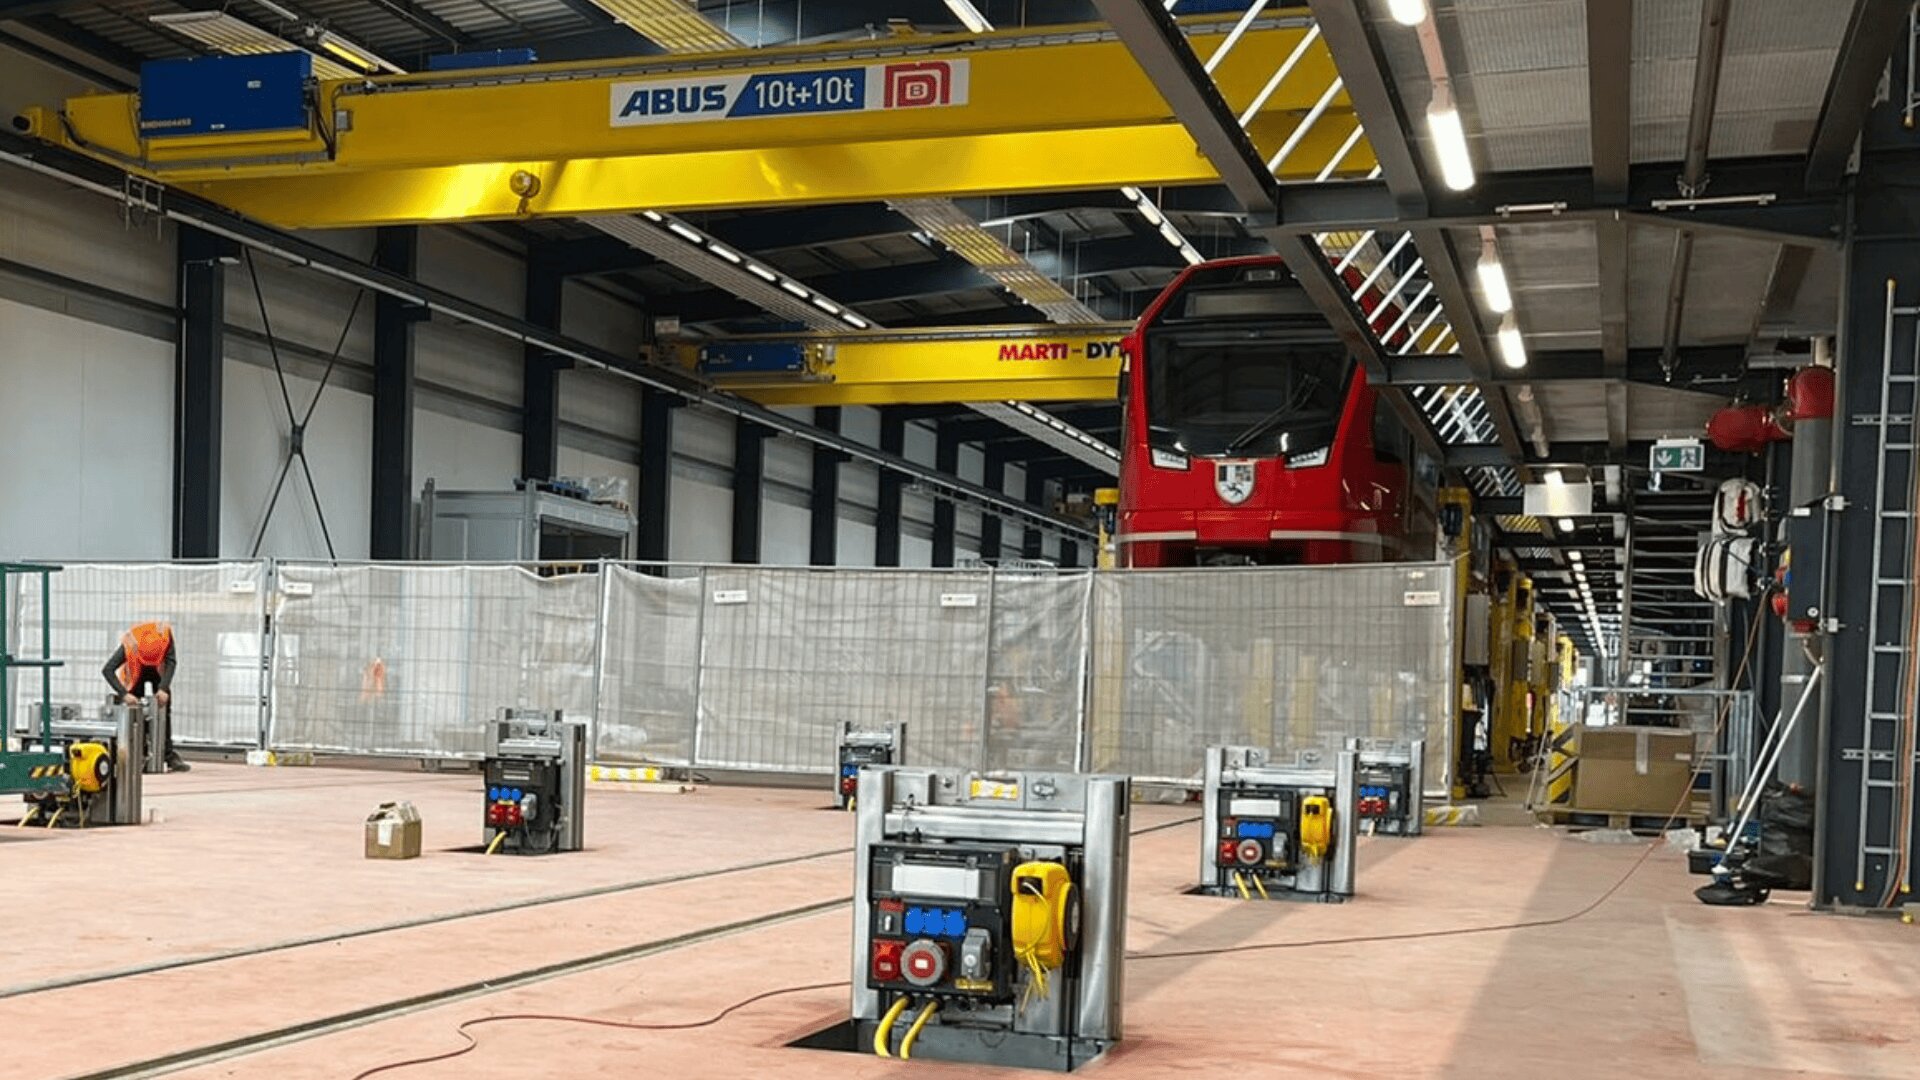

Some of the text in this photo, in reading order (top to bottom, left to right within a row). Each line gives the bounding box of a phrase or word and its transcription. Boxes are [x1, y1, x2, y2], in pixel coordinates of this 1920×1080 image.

[618, 76, 854, 117] ABUS 10t+10t
[998, 343, 1068, 360] MARTI
